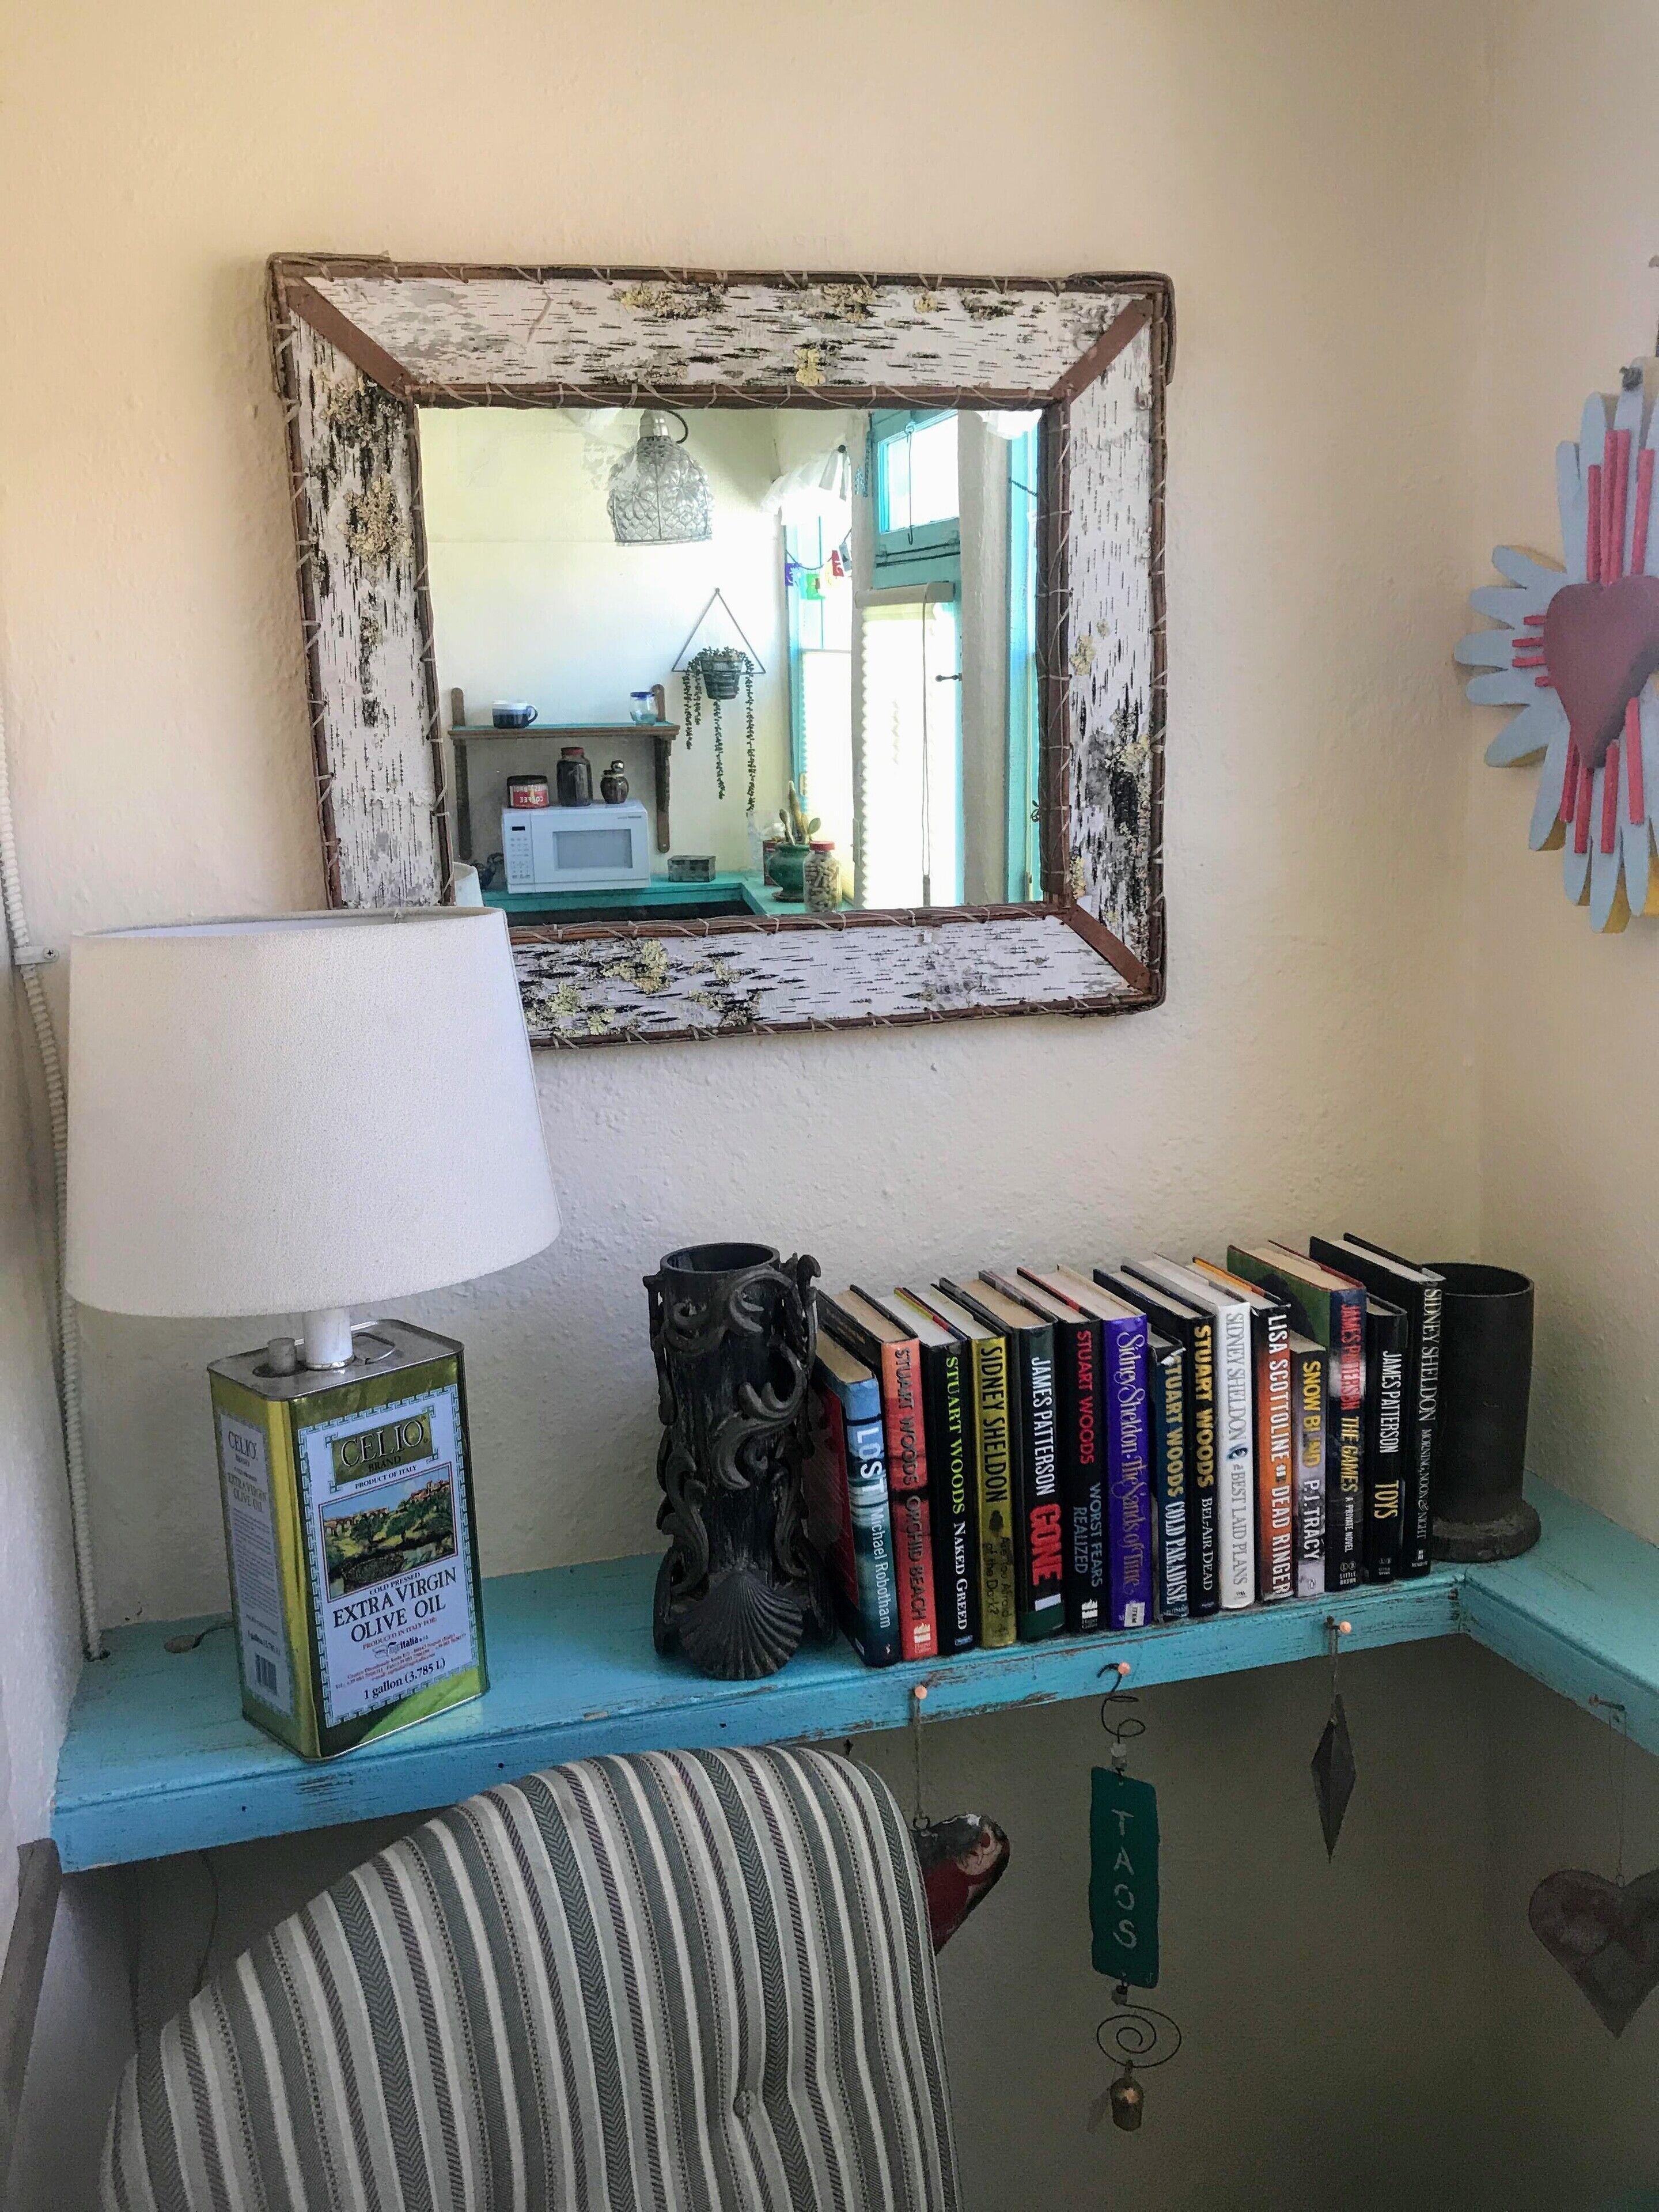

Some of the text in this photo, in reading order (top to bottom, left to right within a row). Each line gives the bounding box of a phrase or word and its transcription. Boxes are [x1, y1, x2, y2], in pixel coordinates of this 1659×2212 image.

[1226, 1313, 1245, 1365] SIDNEY
[1422, 1289, 1441, 1343] SIDNEY
[1113, 1332, 1145, 1384] Sidney
[1419, 1347, 1439, 1422] SHELDON
[946, 1357, 961, 1433] STUART
[1077, 1330, 1094, 1464] STUART WOODS
[1194, 1324, 1214, 1487] STUART WOODS
[1227, 1369, 1247, 1441] SHELDON
[1303, 1361, 1321, 1411] SNOW
[1340, 1304, 1361, 1493] JAMES PATTERSON THE GAMES
[340, 1420, 424, 1467] CELIO
[981, 1346, 1008, 1503] SIDNEY SHELDON
[1118, 1382, 1146, 1455] Sheldon
[1374, 1350, 1402, 1518] JAMES PATTERSON TOYS
[228, 1431, 256, 1460] CELIO
[369, 1455, 401, 1472] BRAND
[1029, 1357, 1062, 1586] JAMES PATTERSON GONE
[1166, 1426, 1184, 1497] WOODS
[1268, 1314, 1291, 1595] LISA SCOTTOLINE DEAD RINGER
[355, 1464, 416, 1489] PRODUCT OF ITALY
[895, 1347, 926, 1620] STUART WOODS ORCHID BEACH
[950, 1438, 965, 1514] WOODS
[1231, 1471, 1246, 1503] BEST
[1419, 1472, 1430, 1499] NOON
[857, 1427, 891, 1629] LOST Michael Robotham
[1073, 1506, 1088, 1574] REALIZED
[1089, 1482, 1103, 1588] WORST FEARS
[1165, 1501, 1185, 1536] COLD
[1202, 1497, 1213, 1550] BEL-AIR
[1232, 1505, 1247, 1539] LAID
[1303, 1506, 1320, 1559] TRACY
[1344, 1532, 1354, 1552] NOVEL
[1345, 1504, 1354, 1531] PRIVATE
[1417, 1513, 1427, 1539] NIGHT
[953, 1521, 966, 1575] NAKED
[1166, 1537, 1187, 1604] PARADISE
[1203, 1551, 1213, 1590] DEAD
[1233, 1541, 1247, 1585] PLANS
[333, 1567, 456, 1628] EXTRA VIRGIN
[369, 1572, 421, 1595] COLD PRESSED
[956, 1578, 968, 1630] GREED
[351, 1594, 446, 1642] OLIVE OIL
[406, 1622, 422, 1633] ITALY
[365, 1690, 369, 1699] 1
[372, 1677, 403, 1699] gallon
[404, 1663, 433, 1684] (3.785
[1111, 1809, 1137, 1949] TAOS
